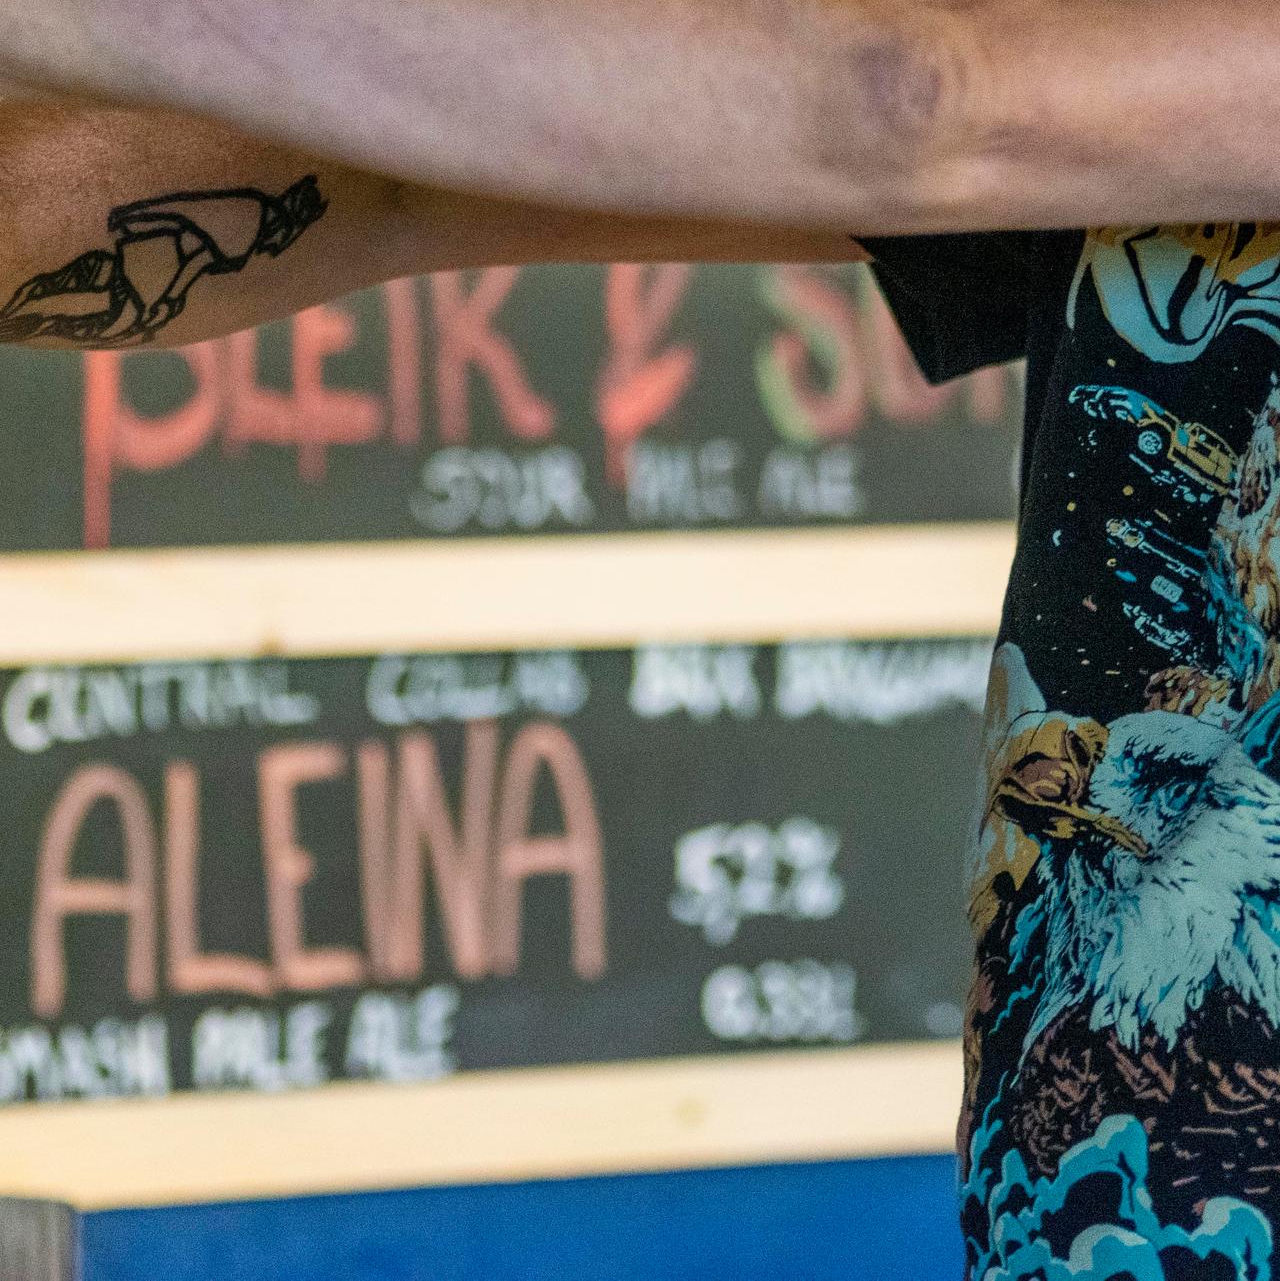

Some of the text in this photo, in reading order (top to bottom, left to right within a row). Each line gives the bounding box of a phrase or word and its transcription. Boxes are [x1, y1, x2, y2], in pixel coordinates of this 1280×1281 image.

[411, 444, 596, 530] SOUR
[2, 660, 322, 755] CENTRAL
[31, 721, 606, 1018] ALEINA
[191, 998, 331, 1094] PALE
[348, 982, 463, 1082] ALE
